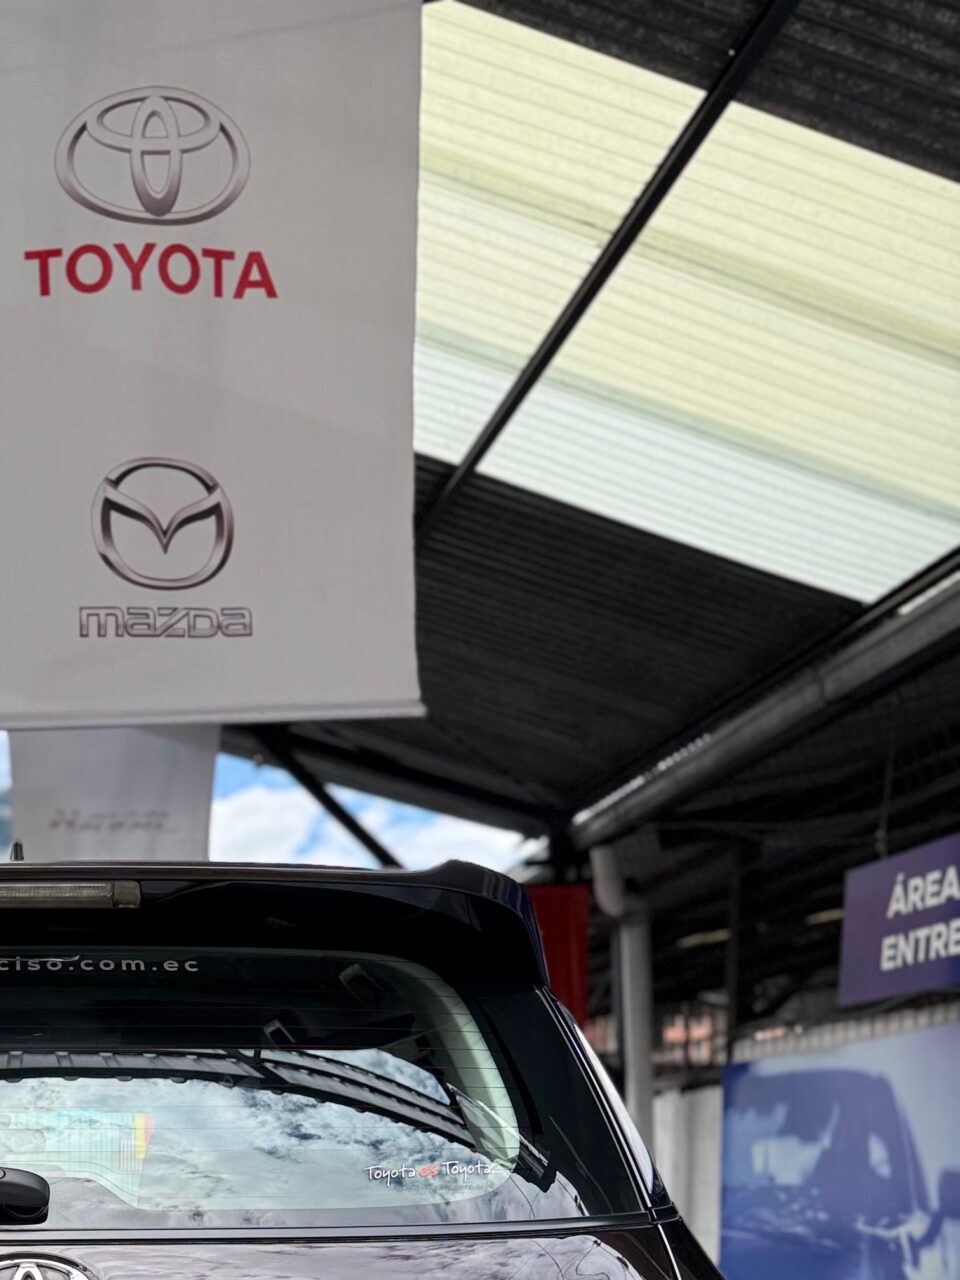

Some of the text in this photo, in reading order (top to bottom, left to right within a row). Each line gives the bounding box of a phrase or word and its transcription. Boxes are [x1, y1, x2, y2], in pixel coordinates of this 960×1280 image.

[24, 242, 278, 298] TOYOTA
[886, 865, 960, 919] ÁREA
[365, 1164, 416, 1187] Toyota
[442, 1160, 491, 1182] Toyota
